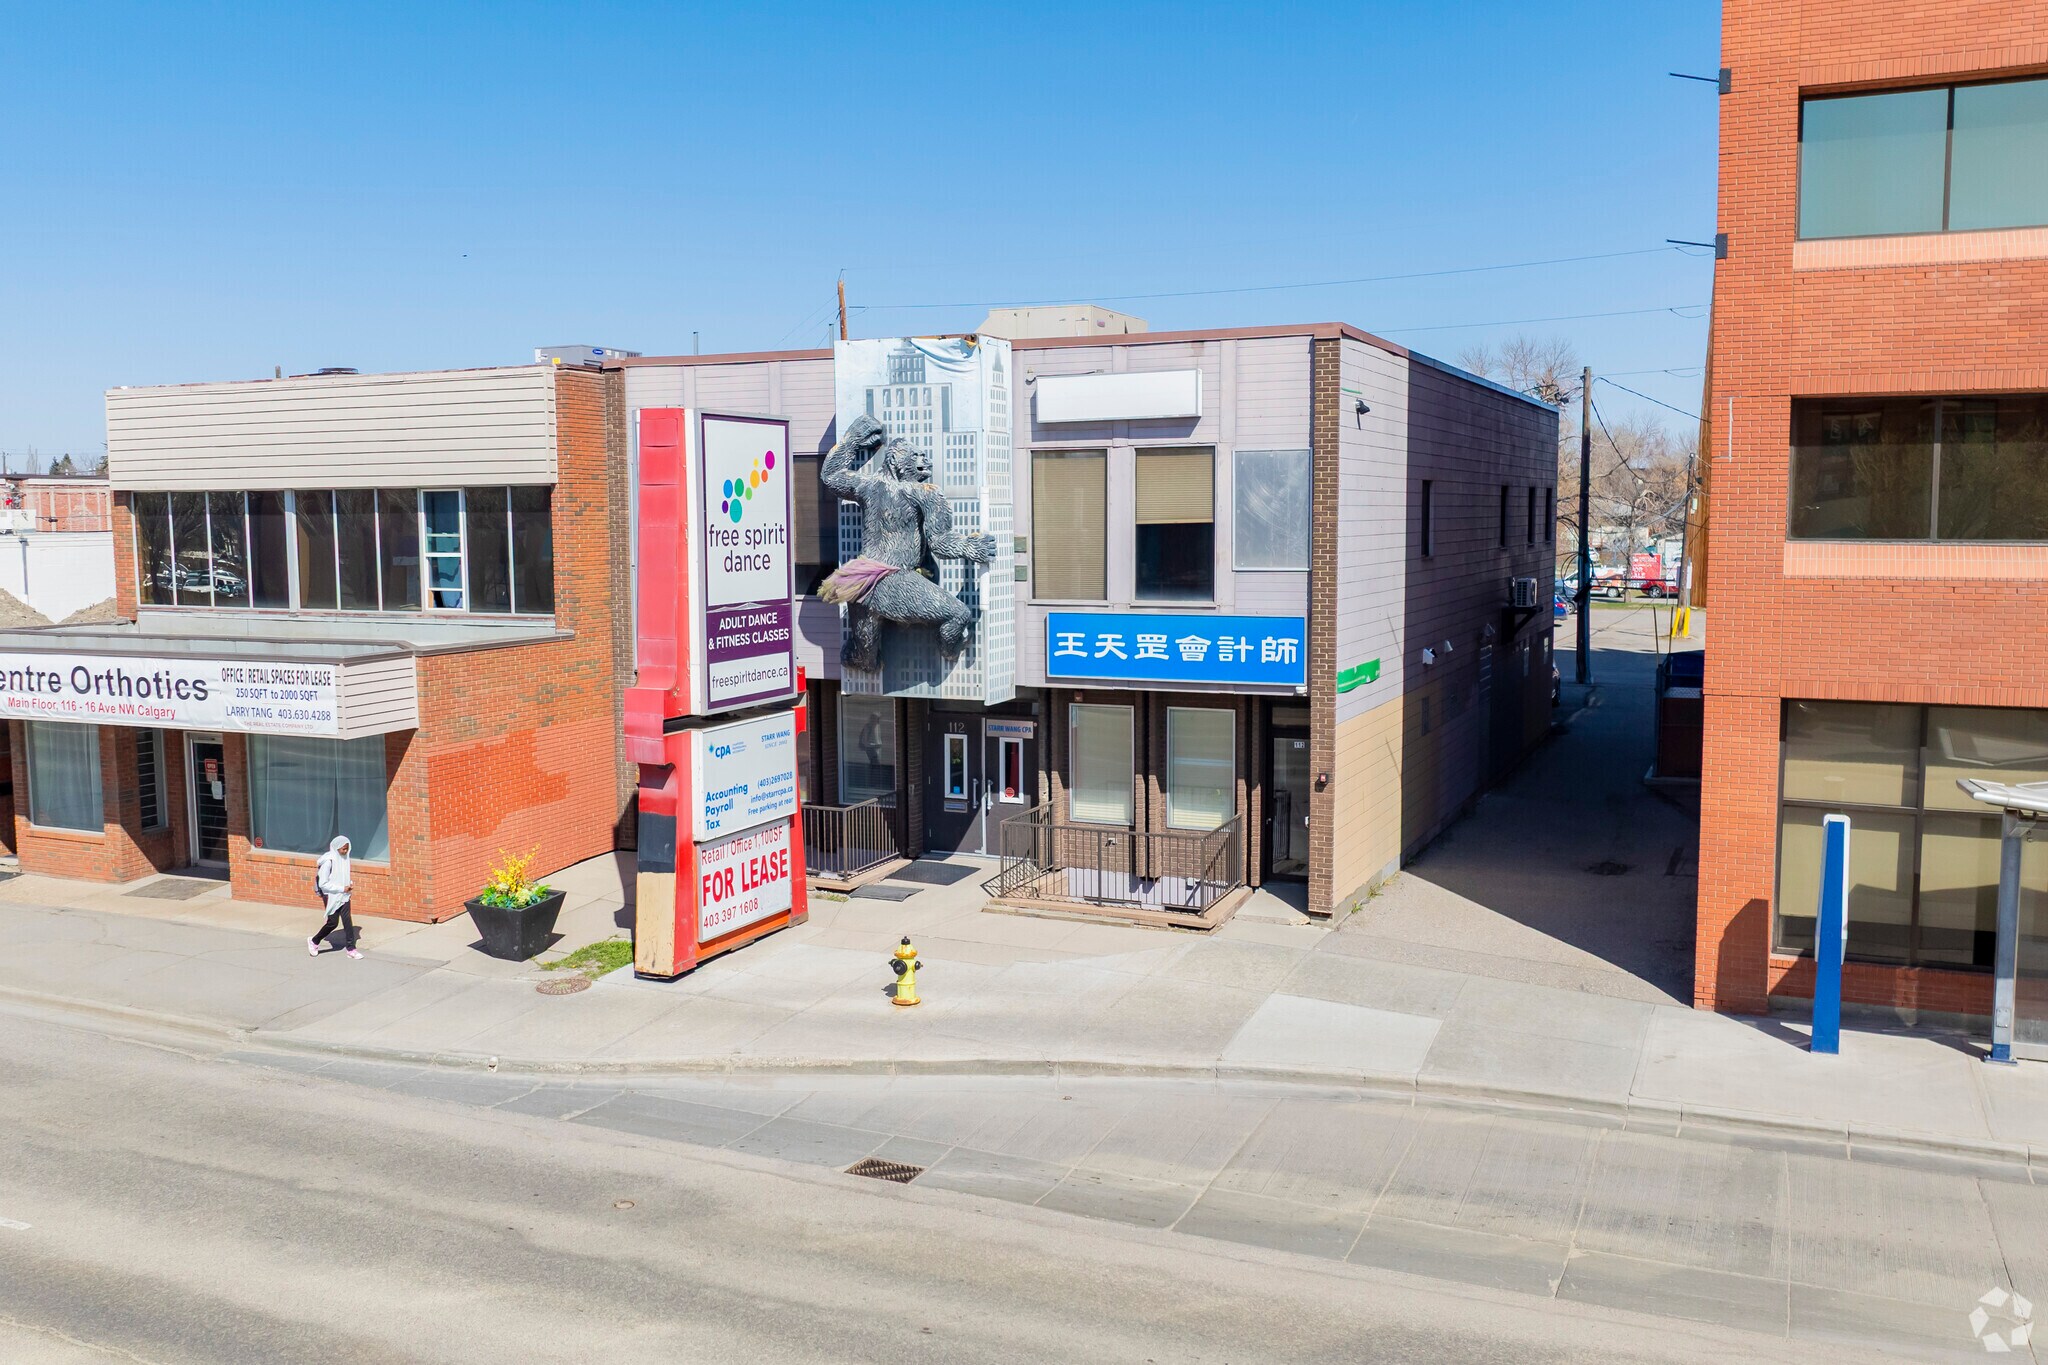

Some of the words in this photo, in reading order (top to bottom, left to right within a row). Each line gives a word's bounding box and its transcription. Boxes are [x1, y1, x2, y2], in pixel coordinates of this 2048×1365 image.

[709, 524, 739, 547] free
[745, 523, 785, 550] spirit
[724, 550, 771, 573] dance
[719, 616, 746, 630] ADULT
[748, 612, 778, 627] DANCE
[708, 637, 715, 650] &
[716, 633, 751, 649] FITNESS
[752, 628, 790, 644] CLASSES
[1053, 631, 1299, 665] 王天罡會計師
[70, 665, 209, 702] Orthotics
[221, 667, 244, 684] OFFICE
[249, 668, 270, 686] RETAIL
[271, 669, 295, 686] SPACES
[296, 670, 310, 686] FOR
[311, 671, 331, 686] LEASE
[712, 666, 788, 689] freespiritdance.ca
[235, 687, 249, 699] 250
[249, 688, 268, 700] SQFT
[270, 690, 279, 700] to
[280, 690, 299, 701] 2000
[299, 690, 318, 702] SQFT
[8, 697, 30, 709] Main
[32, 698, 58, 712] Floor,
[61, 701, 77, 712] 116
[85, 702, 96, 713] 16
[98, 703, 116, 715] Ave
[118, 704, 135, 716] NW
[137, 705, 176, 720] Calgary
[225, 706, 250, 718] LARRY
[251, 708, 273, 719] TANG
[278, 709, 332, 721] 403.630.4288
[761, 733, 775, 742] STARR
[776, 729, 791, 738] WANG
[949, 722, 965, 733] 112
[706, 783, 748, 803] Accounting
[705, 798, 734, 817] Payroll
[747, 807, 759, 816] Free
[759, 802, 778, 814] parking
[778, 799, 784, 807] at
[784, 797, 794, 805] rear
[705, 819, 721, 831] Tax
[701, 843, 725, 865] Retail
[730, 837, 753, 856] Office
[754, 825, 783, 849] 1,100SF
[702, 867, 735, 906] FOR
[742, 848, 788, 892] LEASE
[703, 912, 720, 929] 403
[721, 905, 737, 923] 397
[739, 897, 759, 916] 1608
